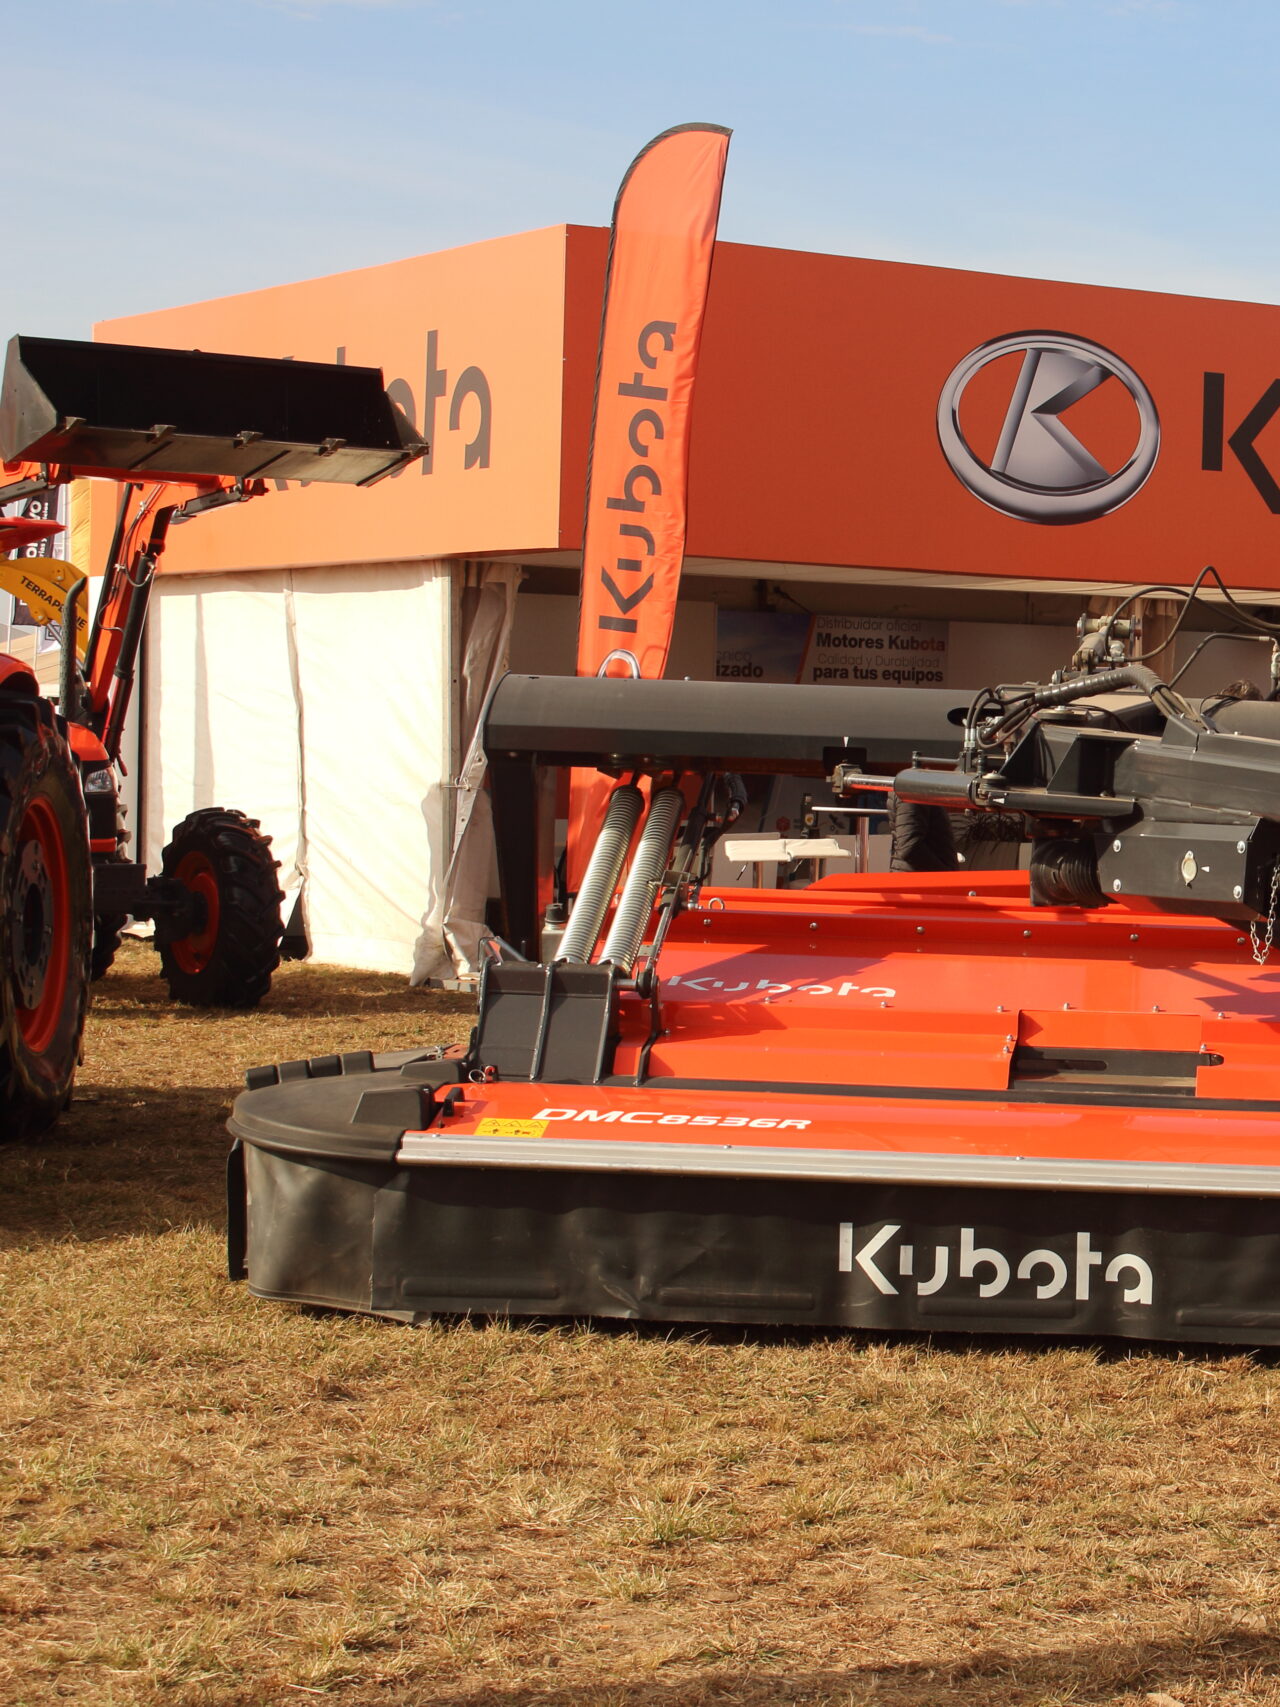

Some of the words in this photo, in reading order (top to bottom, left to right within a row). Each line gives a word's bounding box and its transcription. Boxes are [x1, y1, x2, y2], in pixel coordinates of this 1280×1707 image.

[598, 320, 677, 633] Kubota
[20, 575, 88, 630] TERRAPE
[816, 616, 882, 630] Distribuidor
[886, 618, 922, 632] oficial
[816, 632, 884, 650] Motores
[888, 635, 946, 652] Kubota
[716, 660, 764, 678] izado
[817, 653, 863, 666] Calidad
[866, 657, 872, 668] y
[875, 655, 940, 668] Durabilidad
[813, 666, 848, 682] para
[853, 665, 878, 680] tus
[882, 667, 944, 685] equipos
[667, 975, 896, 998] Kubota
[532, 1107, 812, 1130] DMC8536R
[838, 1222, 1153, 1305] Kubota
